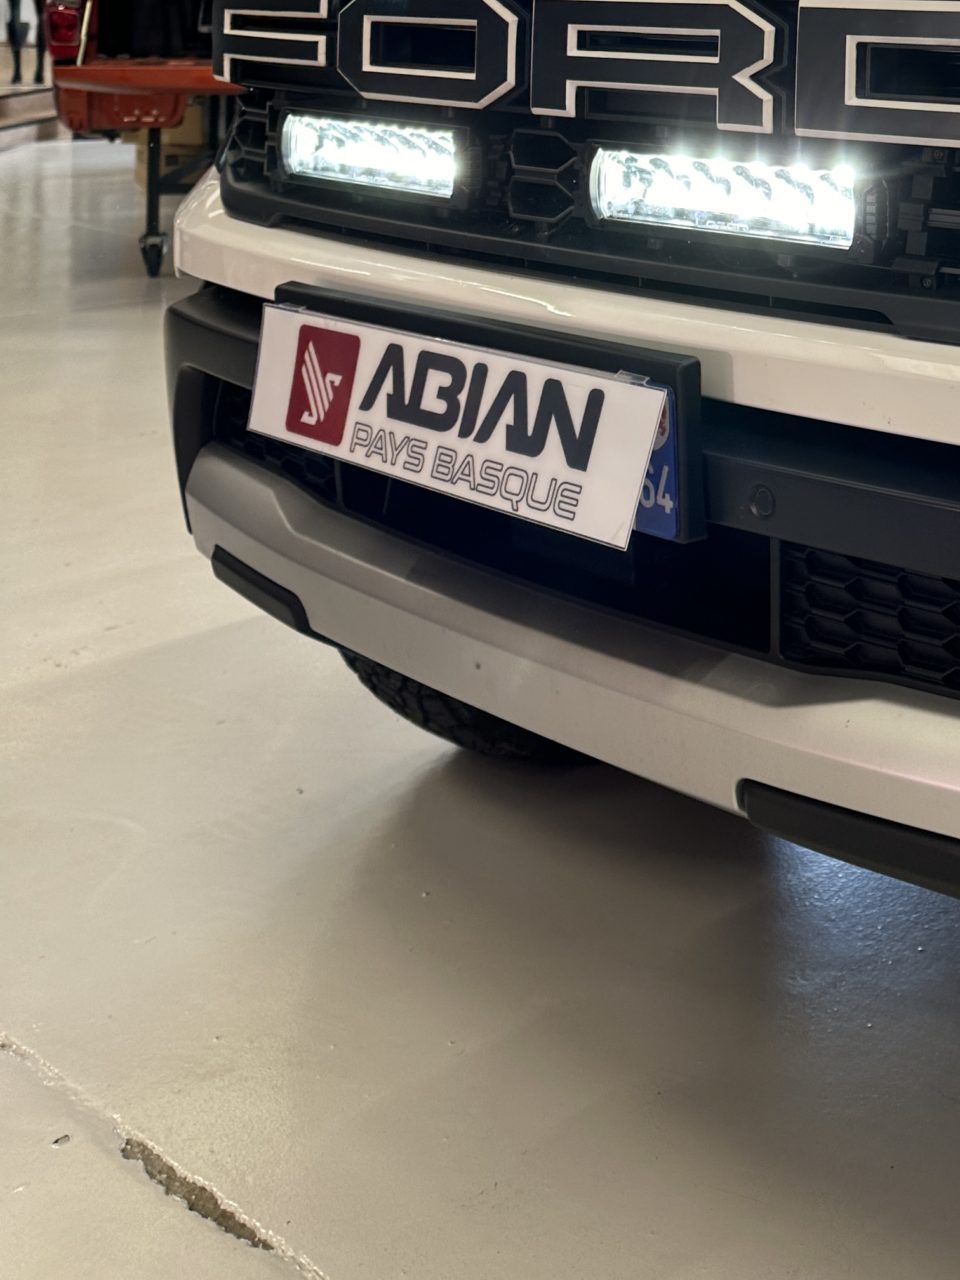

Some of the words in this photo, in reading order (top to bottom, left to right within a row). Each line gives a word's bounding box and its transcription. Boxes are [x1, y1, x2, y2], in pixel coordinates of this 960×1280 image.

[357, 342, 606, 473] ABIAN
[349, 422, 428, 473] PAYS
[430, 446, 583, 521] BASQUE
[640, 464, 674, 515] 64
